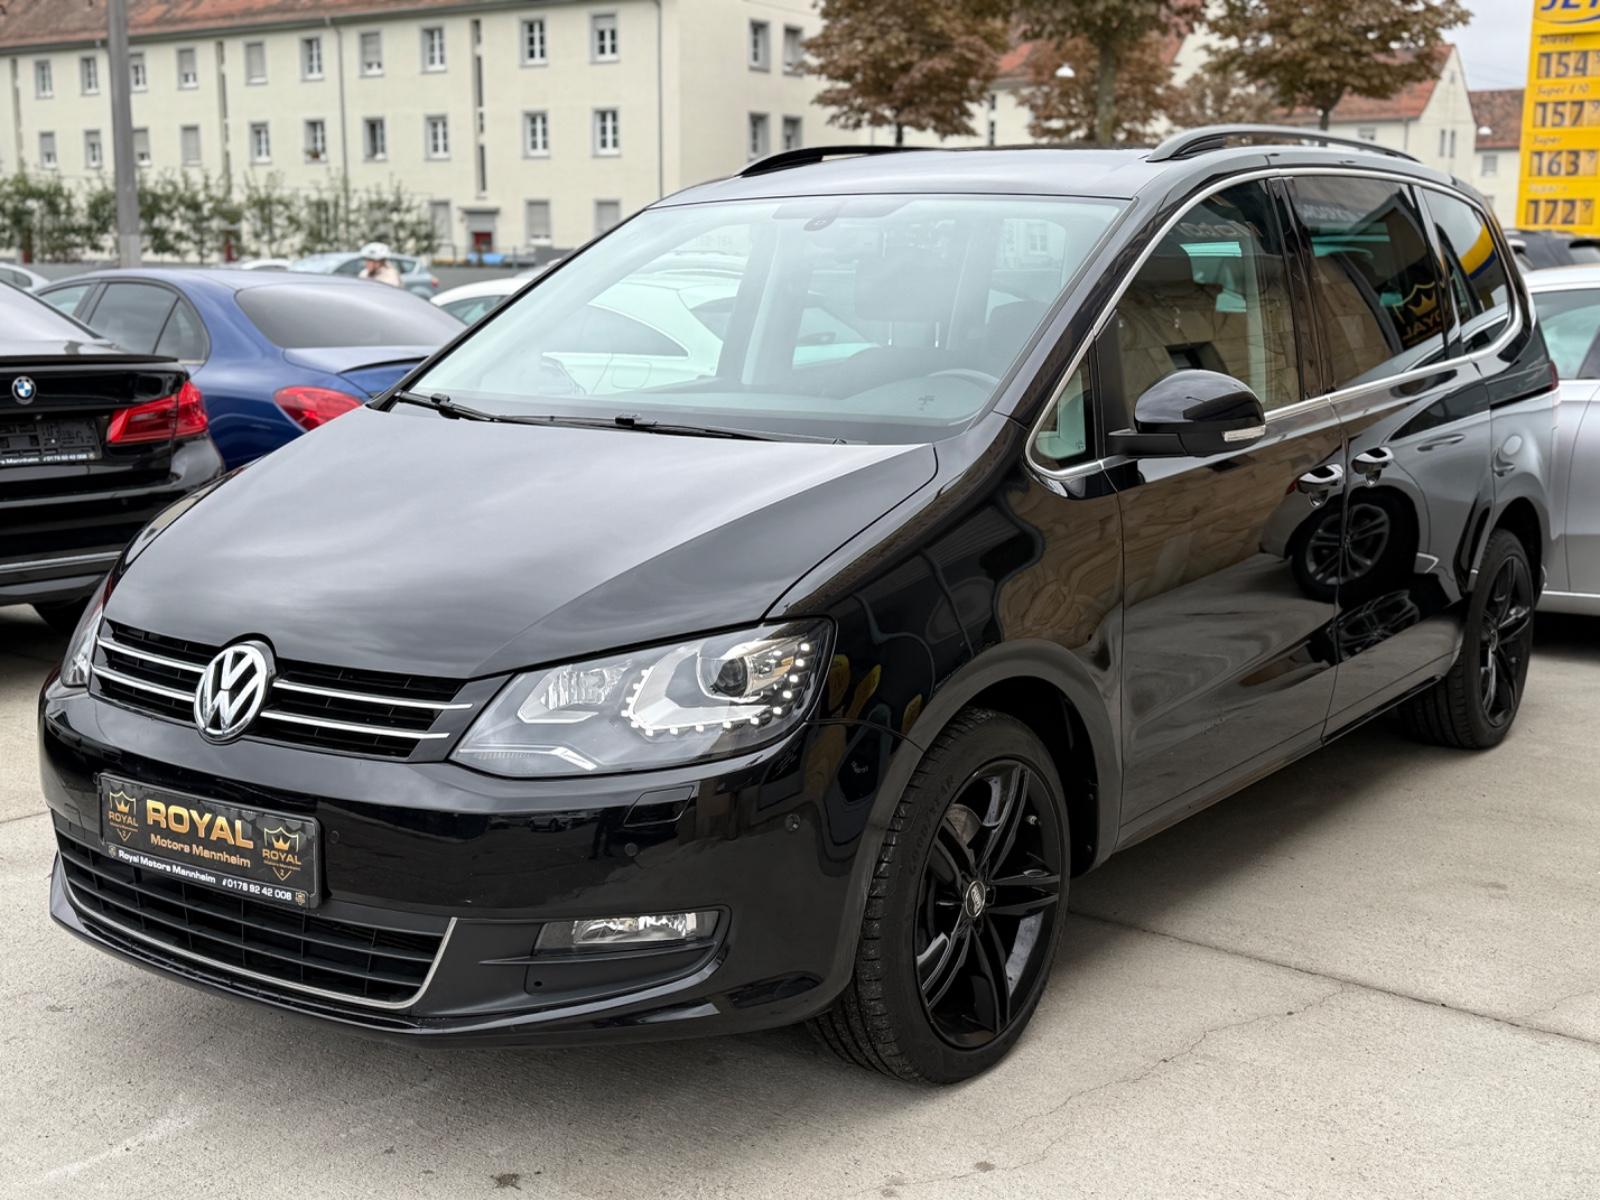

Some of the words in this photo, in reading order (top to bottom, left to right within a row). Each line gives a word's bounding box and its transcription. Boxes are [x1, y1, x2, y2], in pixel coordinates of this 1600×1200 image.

[1538, 51, 1590, 78] 154
[1535, 101, 1585, 128] 157
[1531, 151, 1581, 177] 163
[1527, 199, 1577, 225] 172
[195, 644, 267, 735] VW
[108, 810, 139, 827] ROYAL
[146, 799, 254, 849] ROYAL
[151, 833, 190, 854] Motors
[192, 843, 251, 869] Mannheim
[262, 848, 302, 865] ROYAL
[118, 849, 140, 864] Royal
[140, 856, 171, 873] Motors
[172, 864, 216, 884] Mannheim
[261, 886, 273, 897] 42
